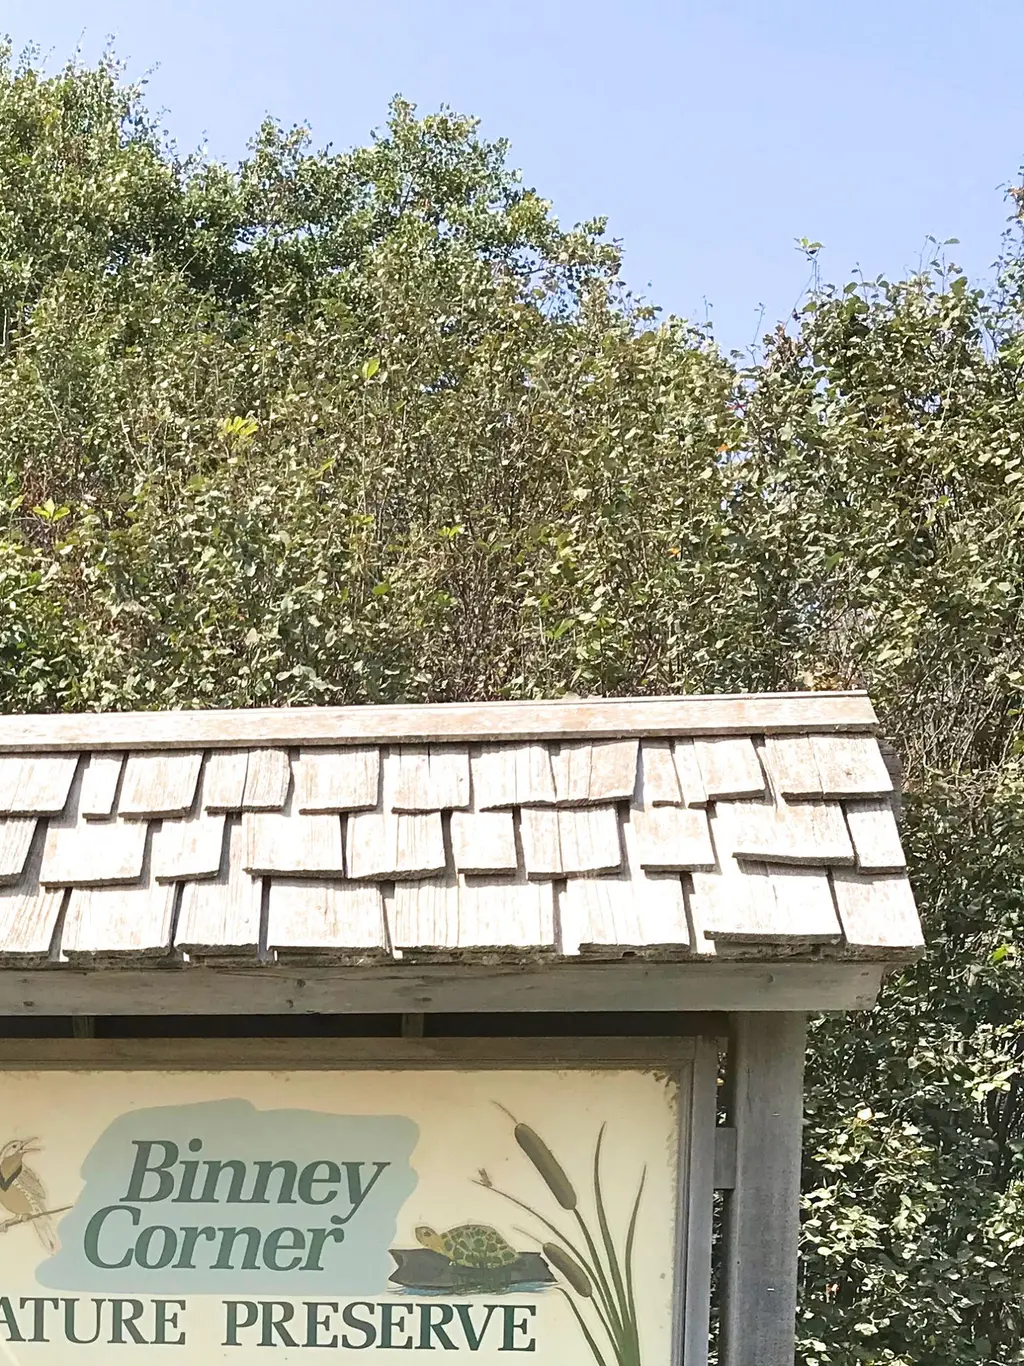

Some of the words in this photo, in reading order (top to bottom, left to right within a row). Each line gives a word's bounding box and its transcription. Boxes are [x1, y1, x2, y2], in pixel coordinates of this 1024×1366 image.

[119, 1138, 390, 1224] Binney
[83, 1204, 345, 1271] Corner
[221, 1299, 537, 1352] PRESERVE
